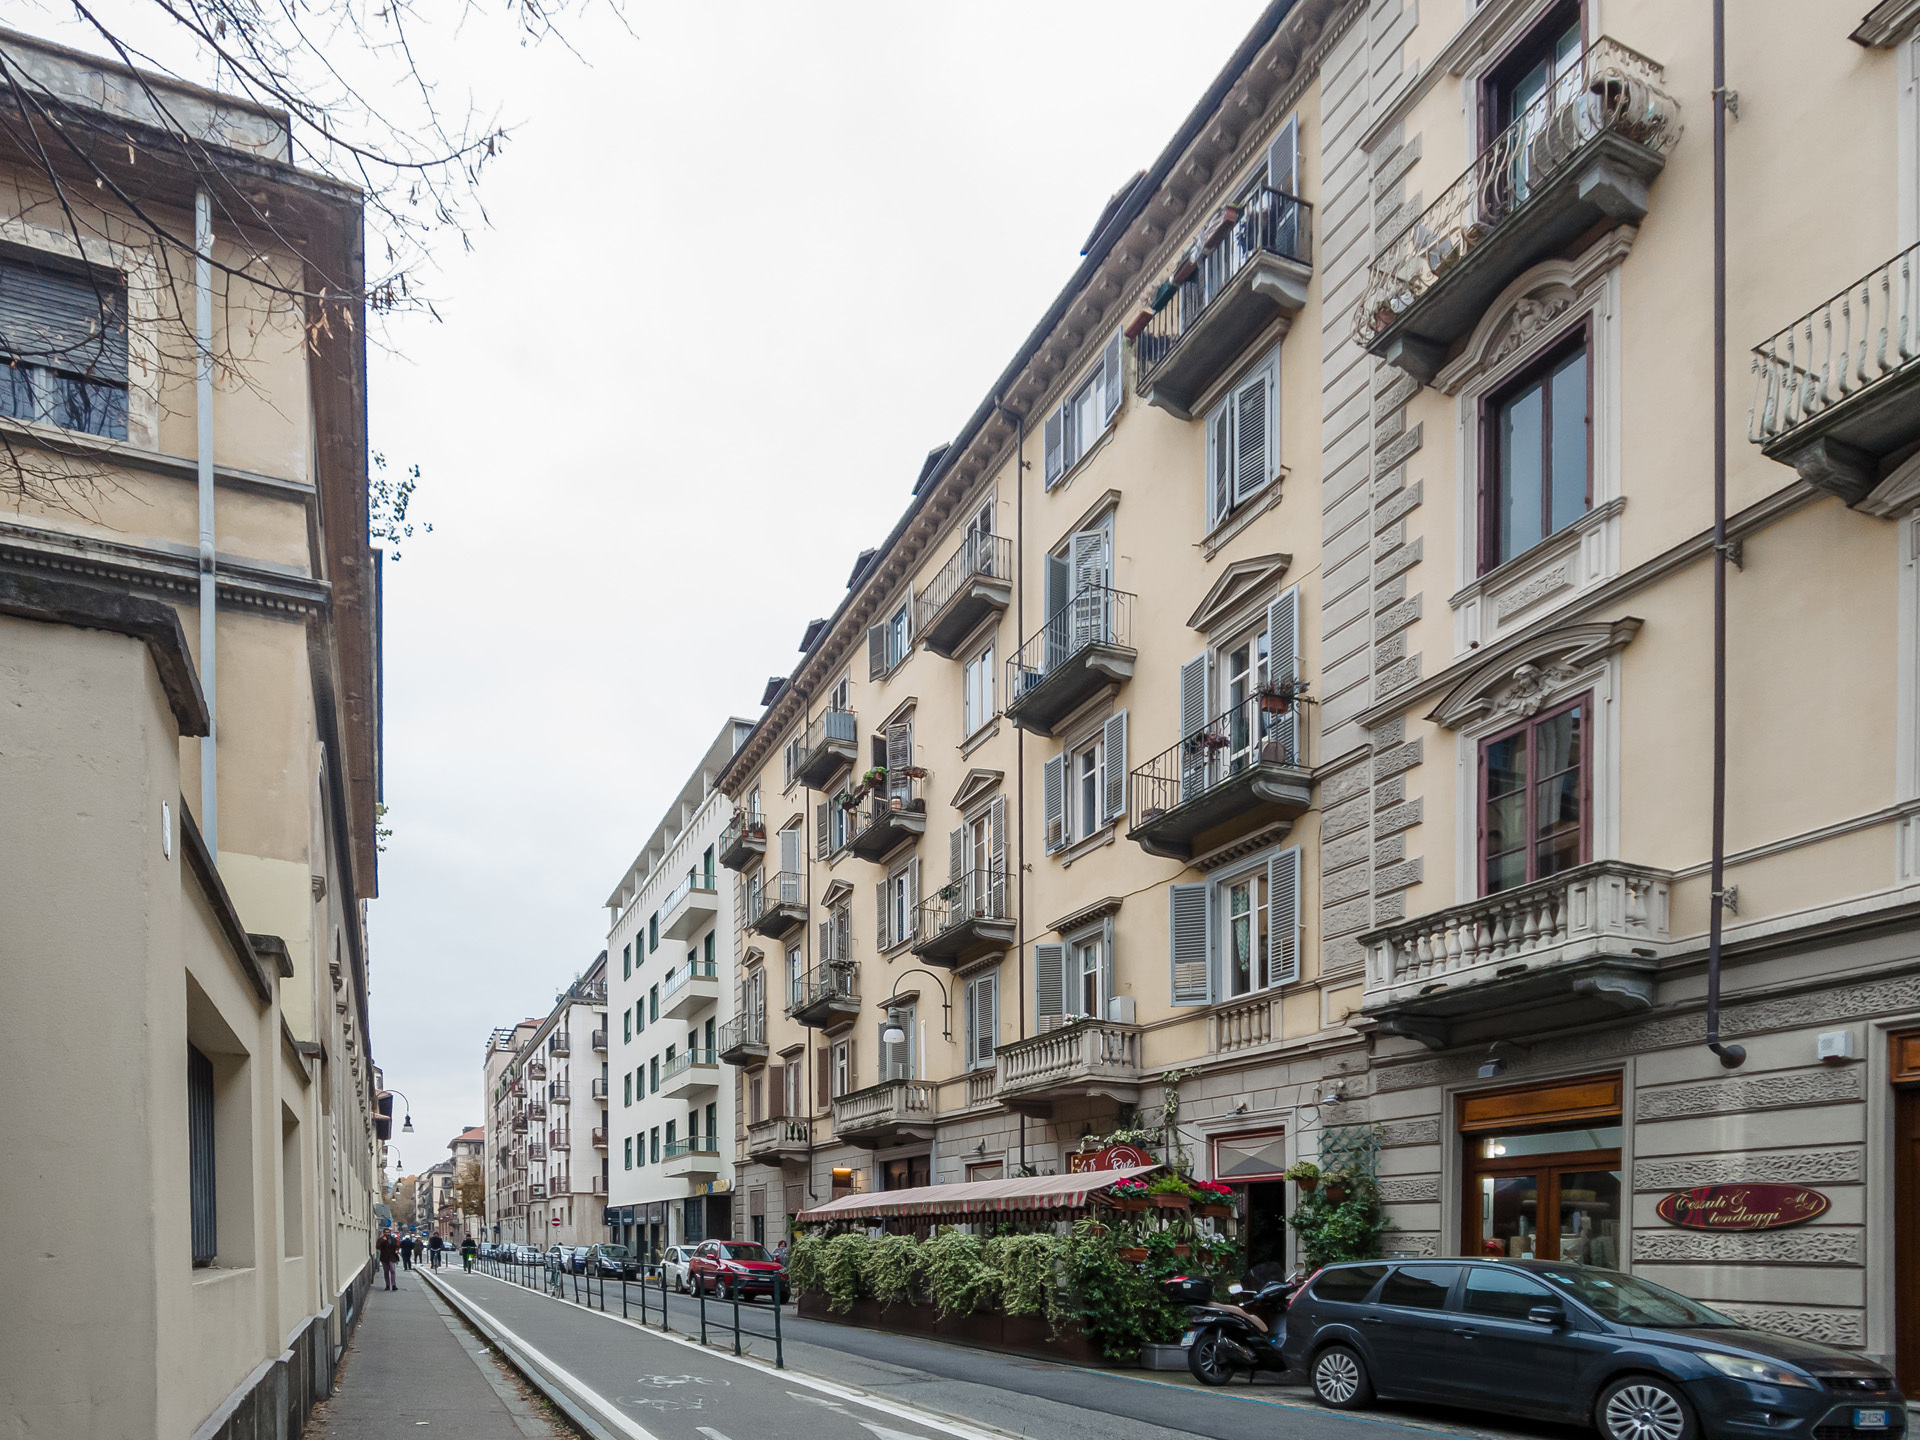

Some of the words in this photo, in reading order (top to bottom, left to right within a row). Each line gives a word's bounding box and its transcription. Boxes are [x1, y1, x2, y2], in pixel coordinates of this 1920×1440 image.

[1675, 1192, 1728, 1211] Tessuti
[1730, 1188, 1750, 1213] &
[1709, 1207, 1782, 1227] tendaggi
